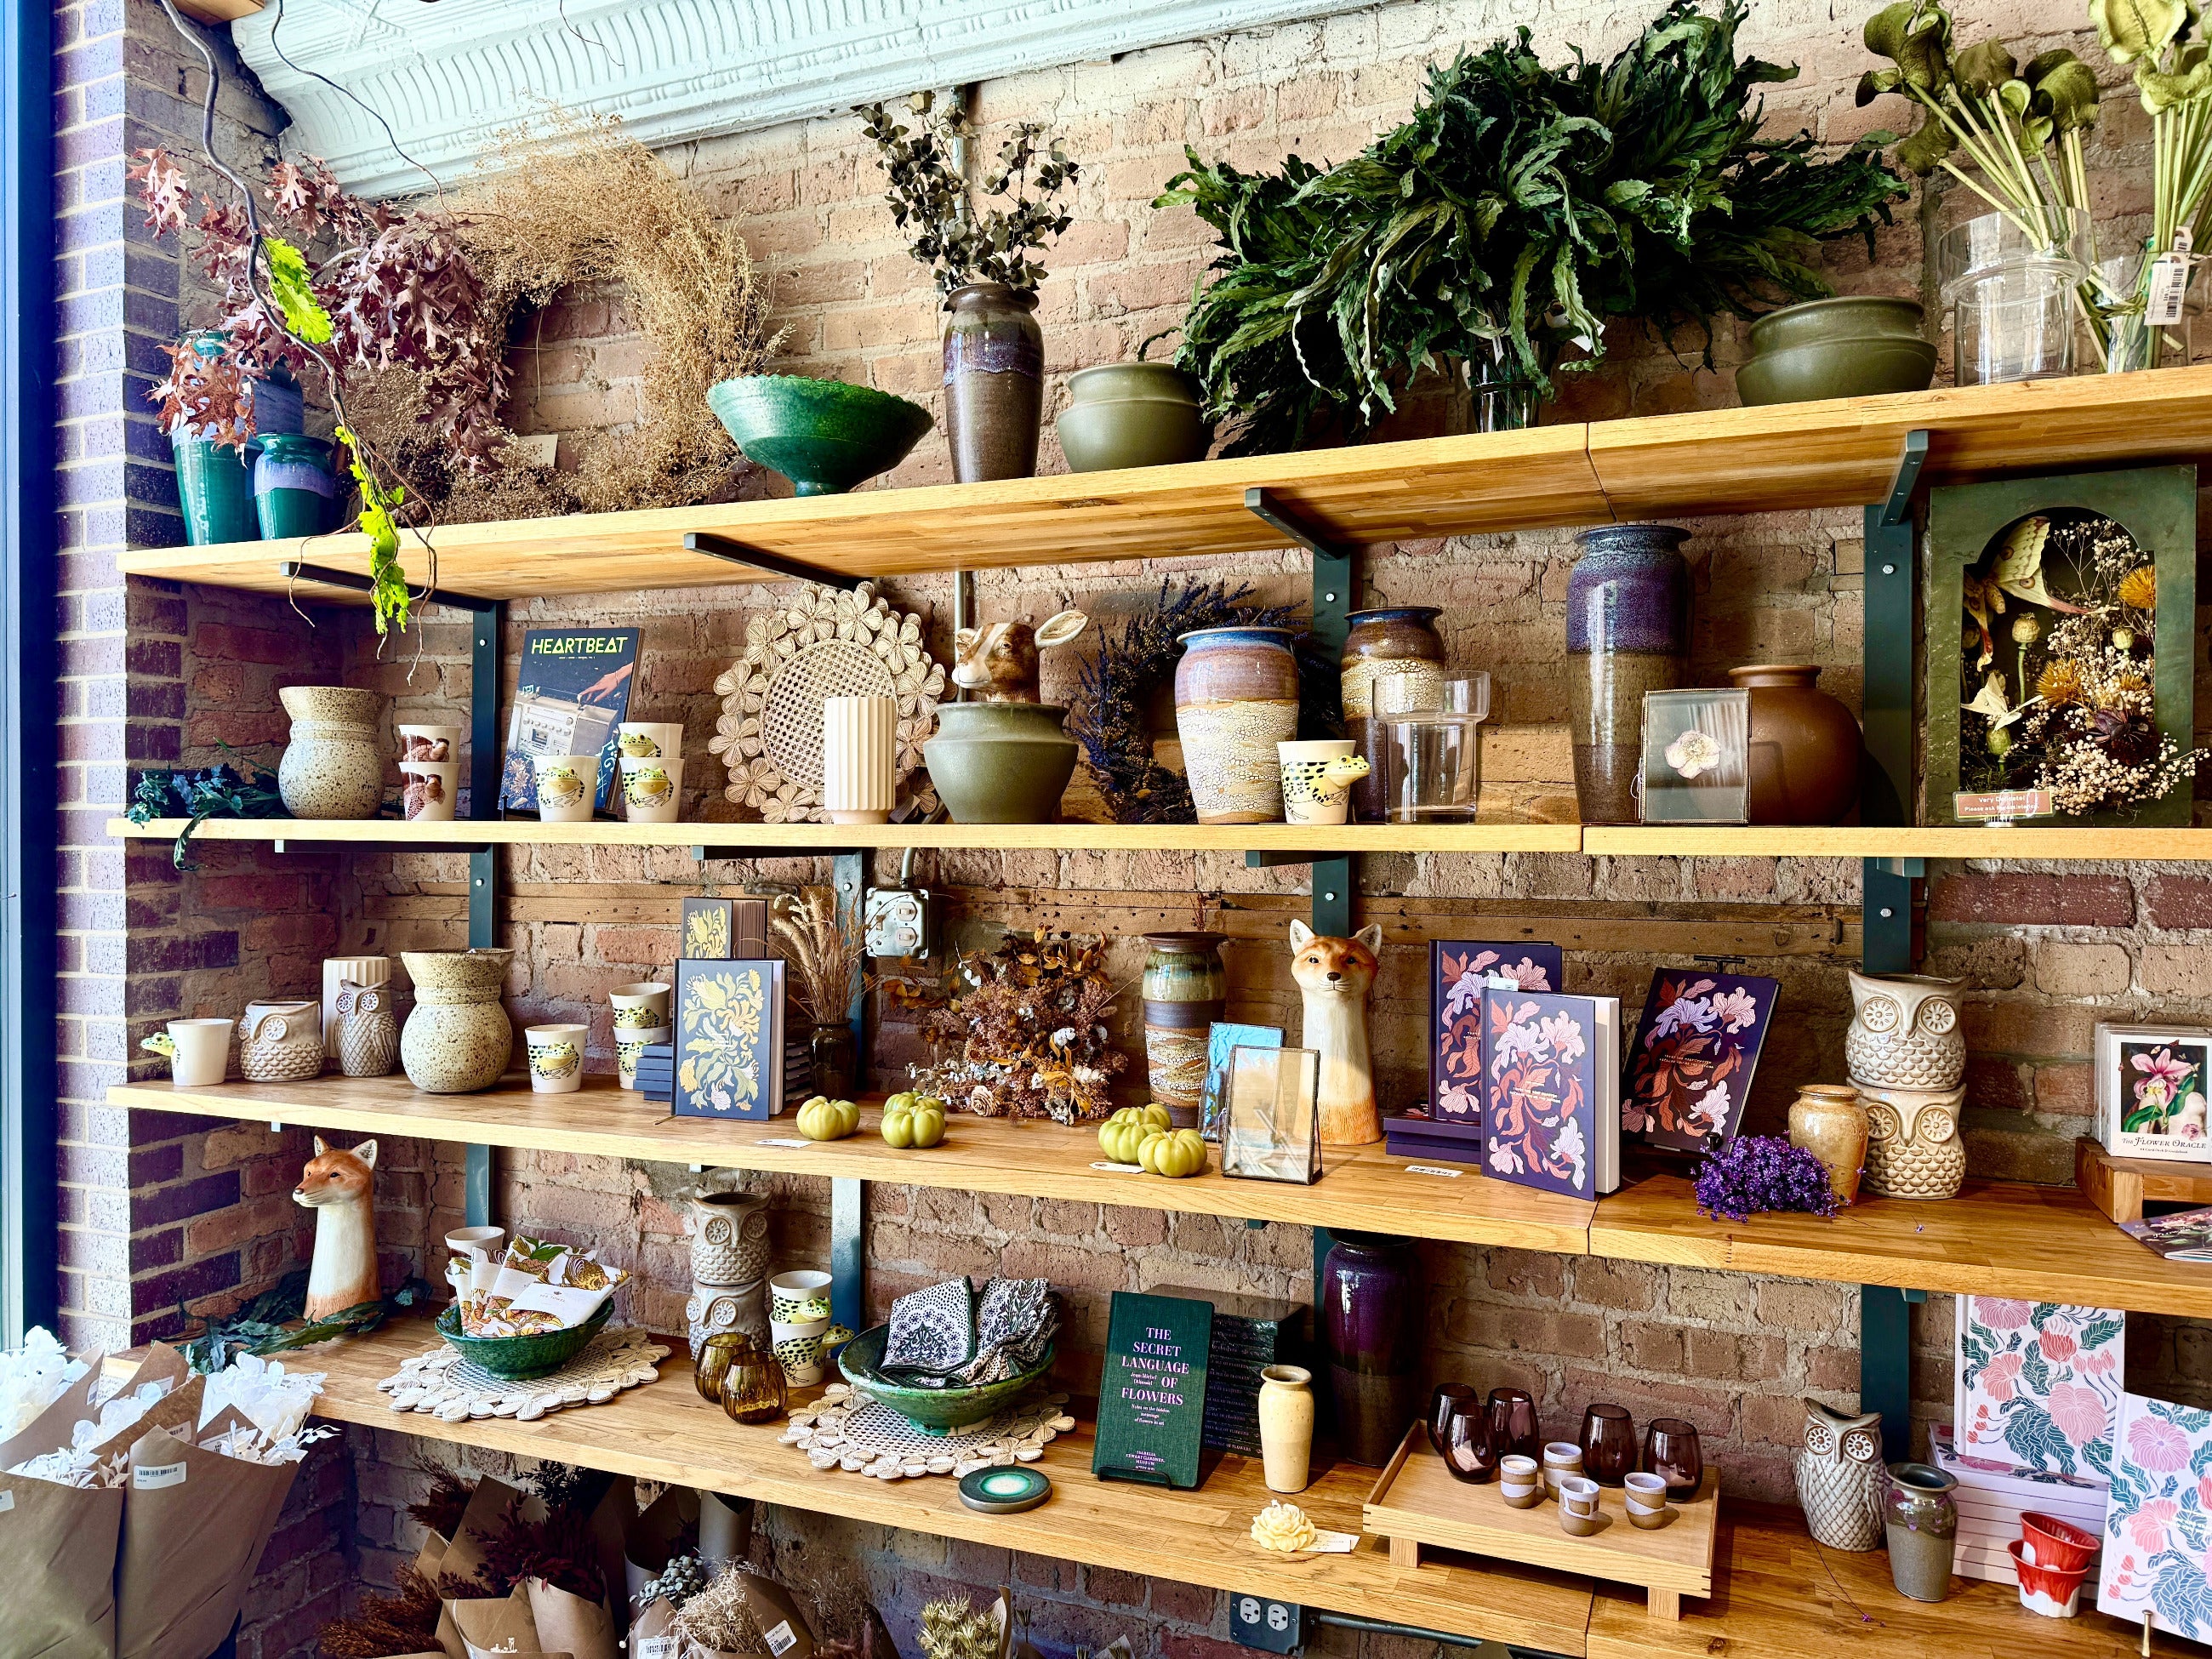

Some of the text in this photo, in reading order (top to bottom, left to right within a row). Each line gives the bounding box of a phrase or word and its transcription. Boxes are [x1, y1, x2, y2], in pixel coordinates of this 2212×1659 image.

[531, 636, 628, 654] HEARTBEAT
[2134, 1137, 2170, 1147] FLOWER
[2172, 1139, 2207, 1149] ORACLE
[1146, 1327, 1172, 1341] THE
[1133, 1341, 1181, 1357] SECRET
[1122, 1356, 1189, 1374] LANGUAGE
[1161, 1377, 1178, 1388] OF
[1122, 1387, 1183, 1405] FLOWERS
